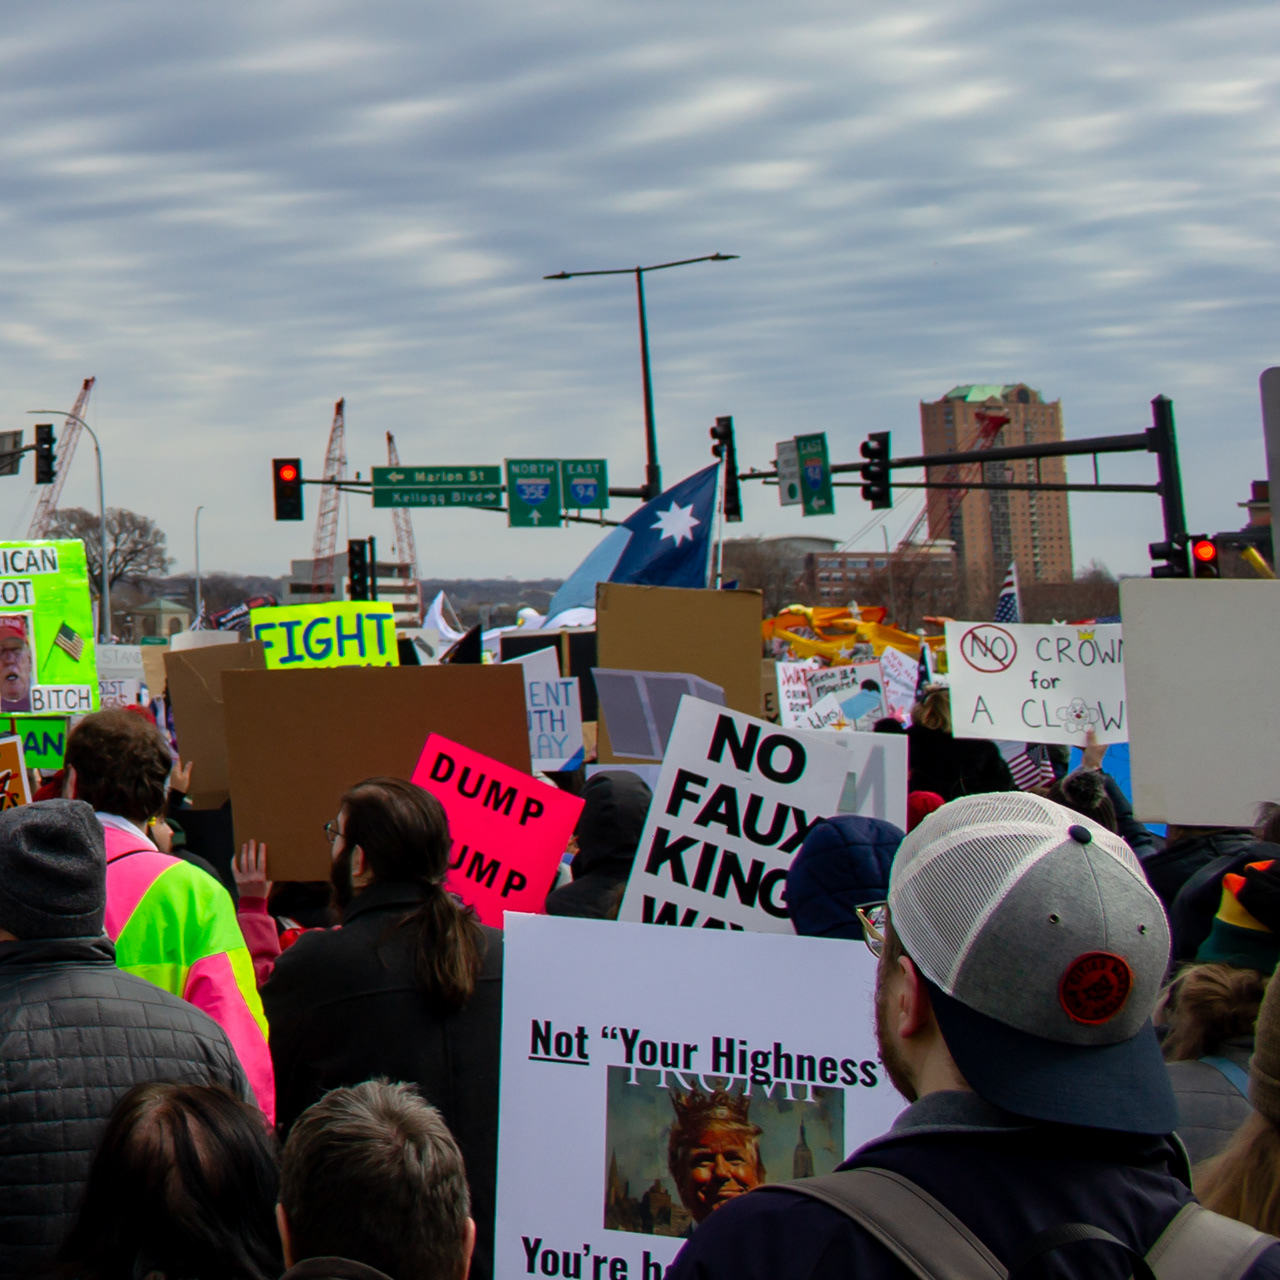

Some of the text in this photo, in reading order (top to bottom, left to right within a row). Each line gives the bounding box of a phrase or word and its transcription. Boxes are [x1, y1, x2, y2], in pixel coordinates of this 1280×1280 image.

[415, 471, 485, 482] Marion St
[512, 464, 555, 474] NORTH
[568, 463, 600, 474] EAST
[393, 492, 482, 505] Kellogg Blvd
[522, 485, 546, 500] 35E
[576, 486, 595, 498] 94
[254, 613, 394, 665] FIGHT
[970, 636, 1009, 662] NO
[1030, 670, 1061, 690] for
[32, 689, 90, 710] BITCH
[971, 695, 994, 725] A
[707, 713, 807, 784] NO
[429, 751, 545, 827] DUMP
[665, 768, 828, 855] FAUX
[644, 826, 792, 920] KING
[530, 1019, 589, 1061] Not
[601, 1025, 699, 1071] “Your
